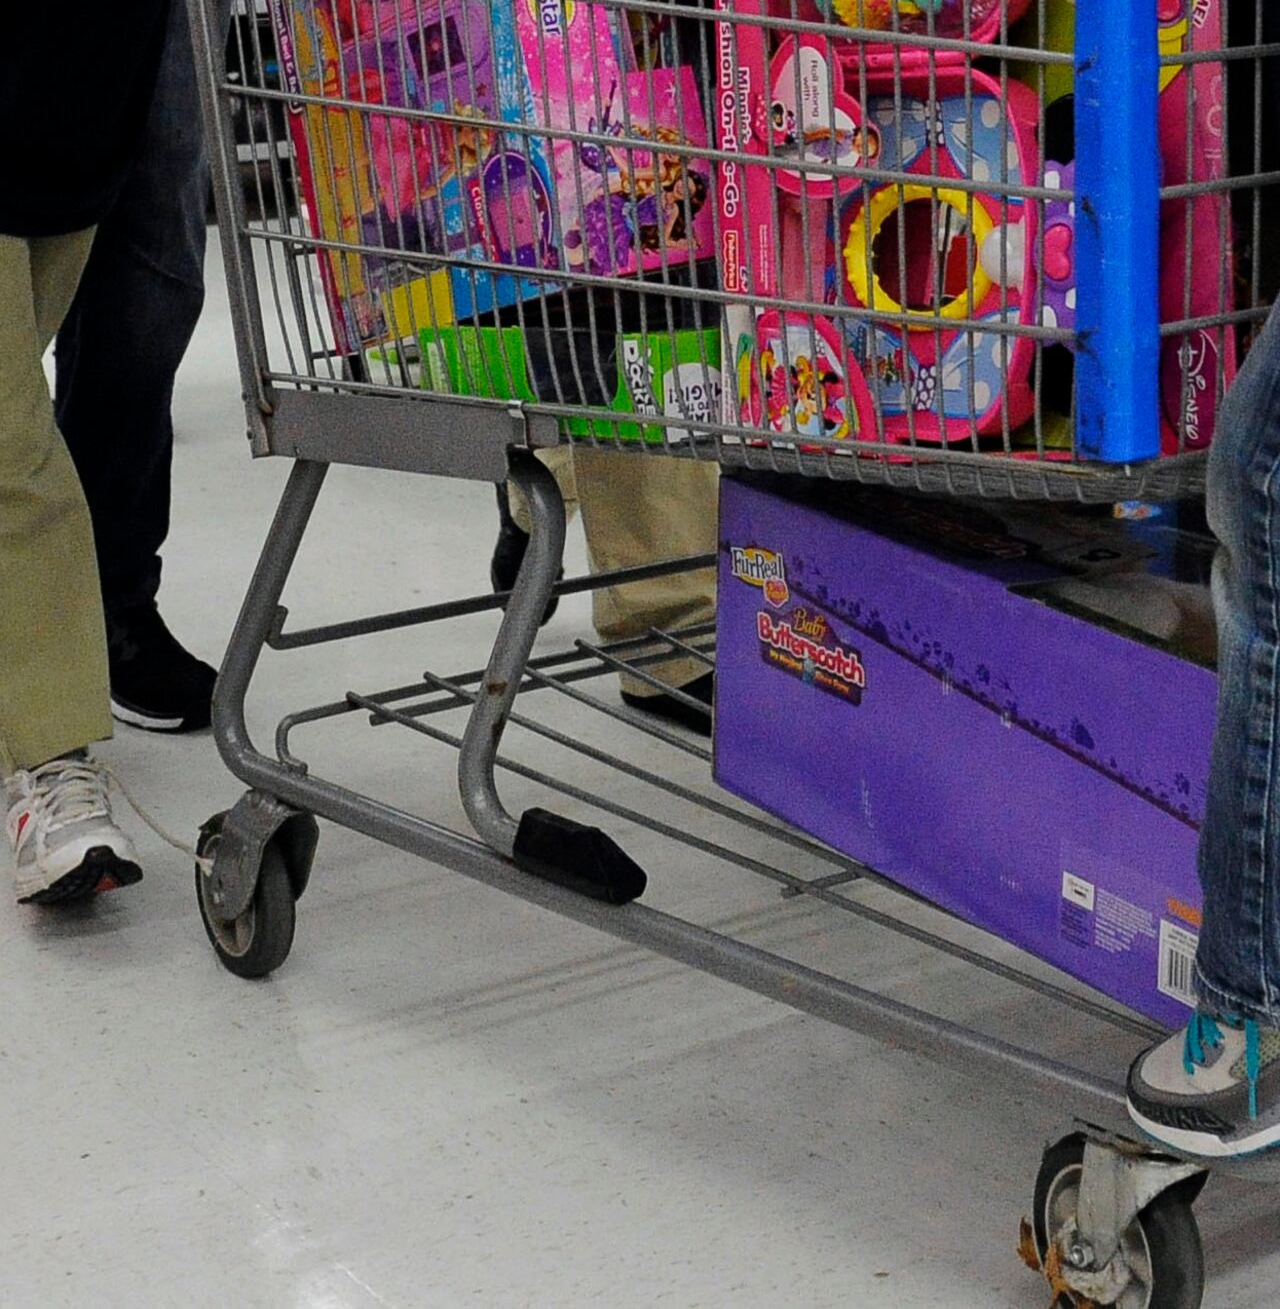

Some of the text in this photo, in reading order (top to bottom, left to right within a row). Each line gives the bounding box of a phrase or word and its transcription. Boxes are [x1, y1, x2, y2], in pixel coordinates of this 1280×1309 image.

[731, 547, 784, 579] FurReal
[794, 608, 827, 639] Baby
[758, 612, 865, 688] Butterscotch
